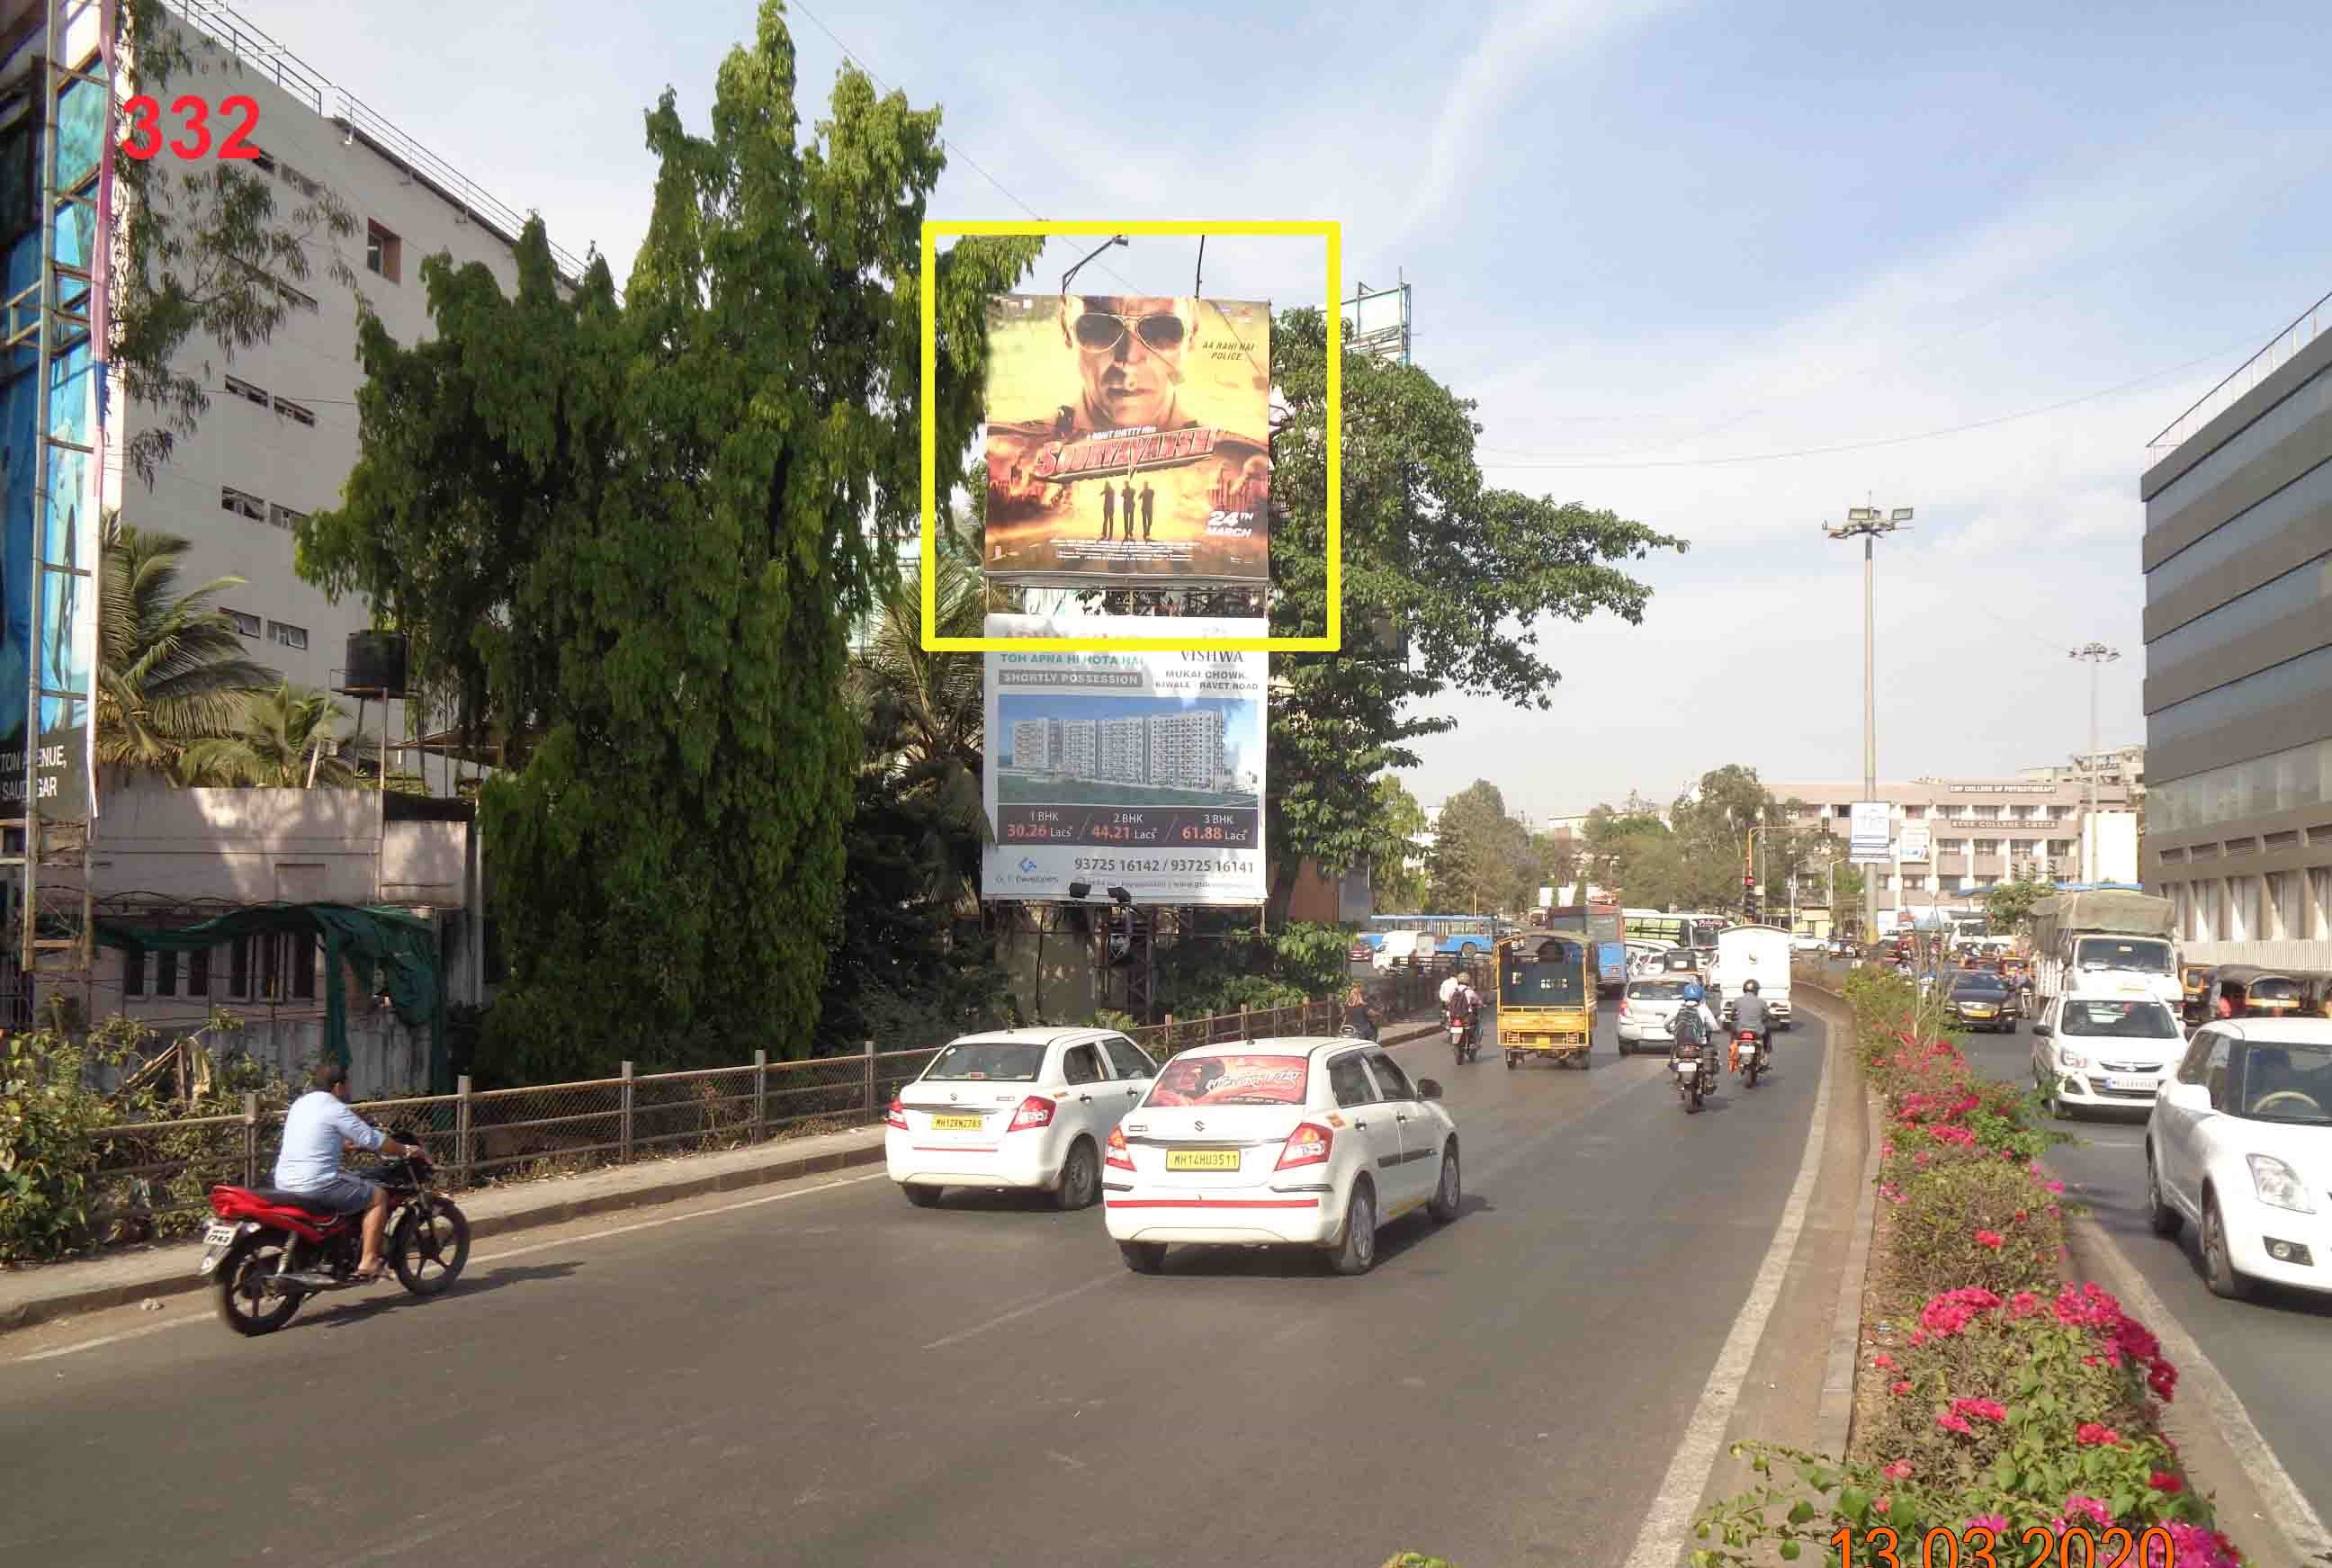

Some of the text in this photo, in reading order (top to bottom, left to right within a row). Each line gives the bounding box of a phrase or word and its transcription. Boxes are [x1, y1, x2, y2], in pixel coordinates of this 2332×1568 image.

[1211, 352, 1243, 361] POLICE
[1206, 527, 1251, 538] MARCH
[1000, 653, 1027, 663] TOH
[1030, 654, 1063, 663] APNA
[1067, 655, 1079, 663] HI
[1084, 655, 1117, 665] HOTA
[1181, 650, 1243, 662] VISHWA
[1004, 673, 1138, 685] SHORTLY POSSESSION
[1166, 670, 1245, 679] MUKAI CHOWK
[1200, 682, 1230, 690] RAVET
[22, 744, 67, 771] AENUE,
[3, 775, 58, 802] SAUDGAR
[1038, 811, 1059, 821] BHK
[1114, 813, 1120, 822] 2
[1122, 813, 1143, 823] BHK
[1204, 814, 1210, 823] 3
[1213, 814, 1233, 824] BHK
[1007, 824, 1047, 837] 30.26
[1093, 825, 1130, 838] 44.21
[1181, 827, 1224, 840] 61.88
[1074, 857, 1116, 871] 93725
[1121, 859, 1160, 872] 16142
[1170, 859, 1211, 872] 93725
[1216, 860, 1253, 874] 16141
[1174, 1153, 1237, 1167] MH14HU3511
